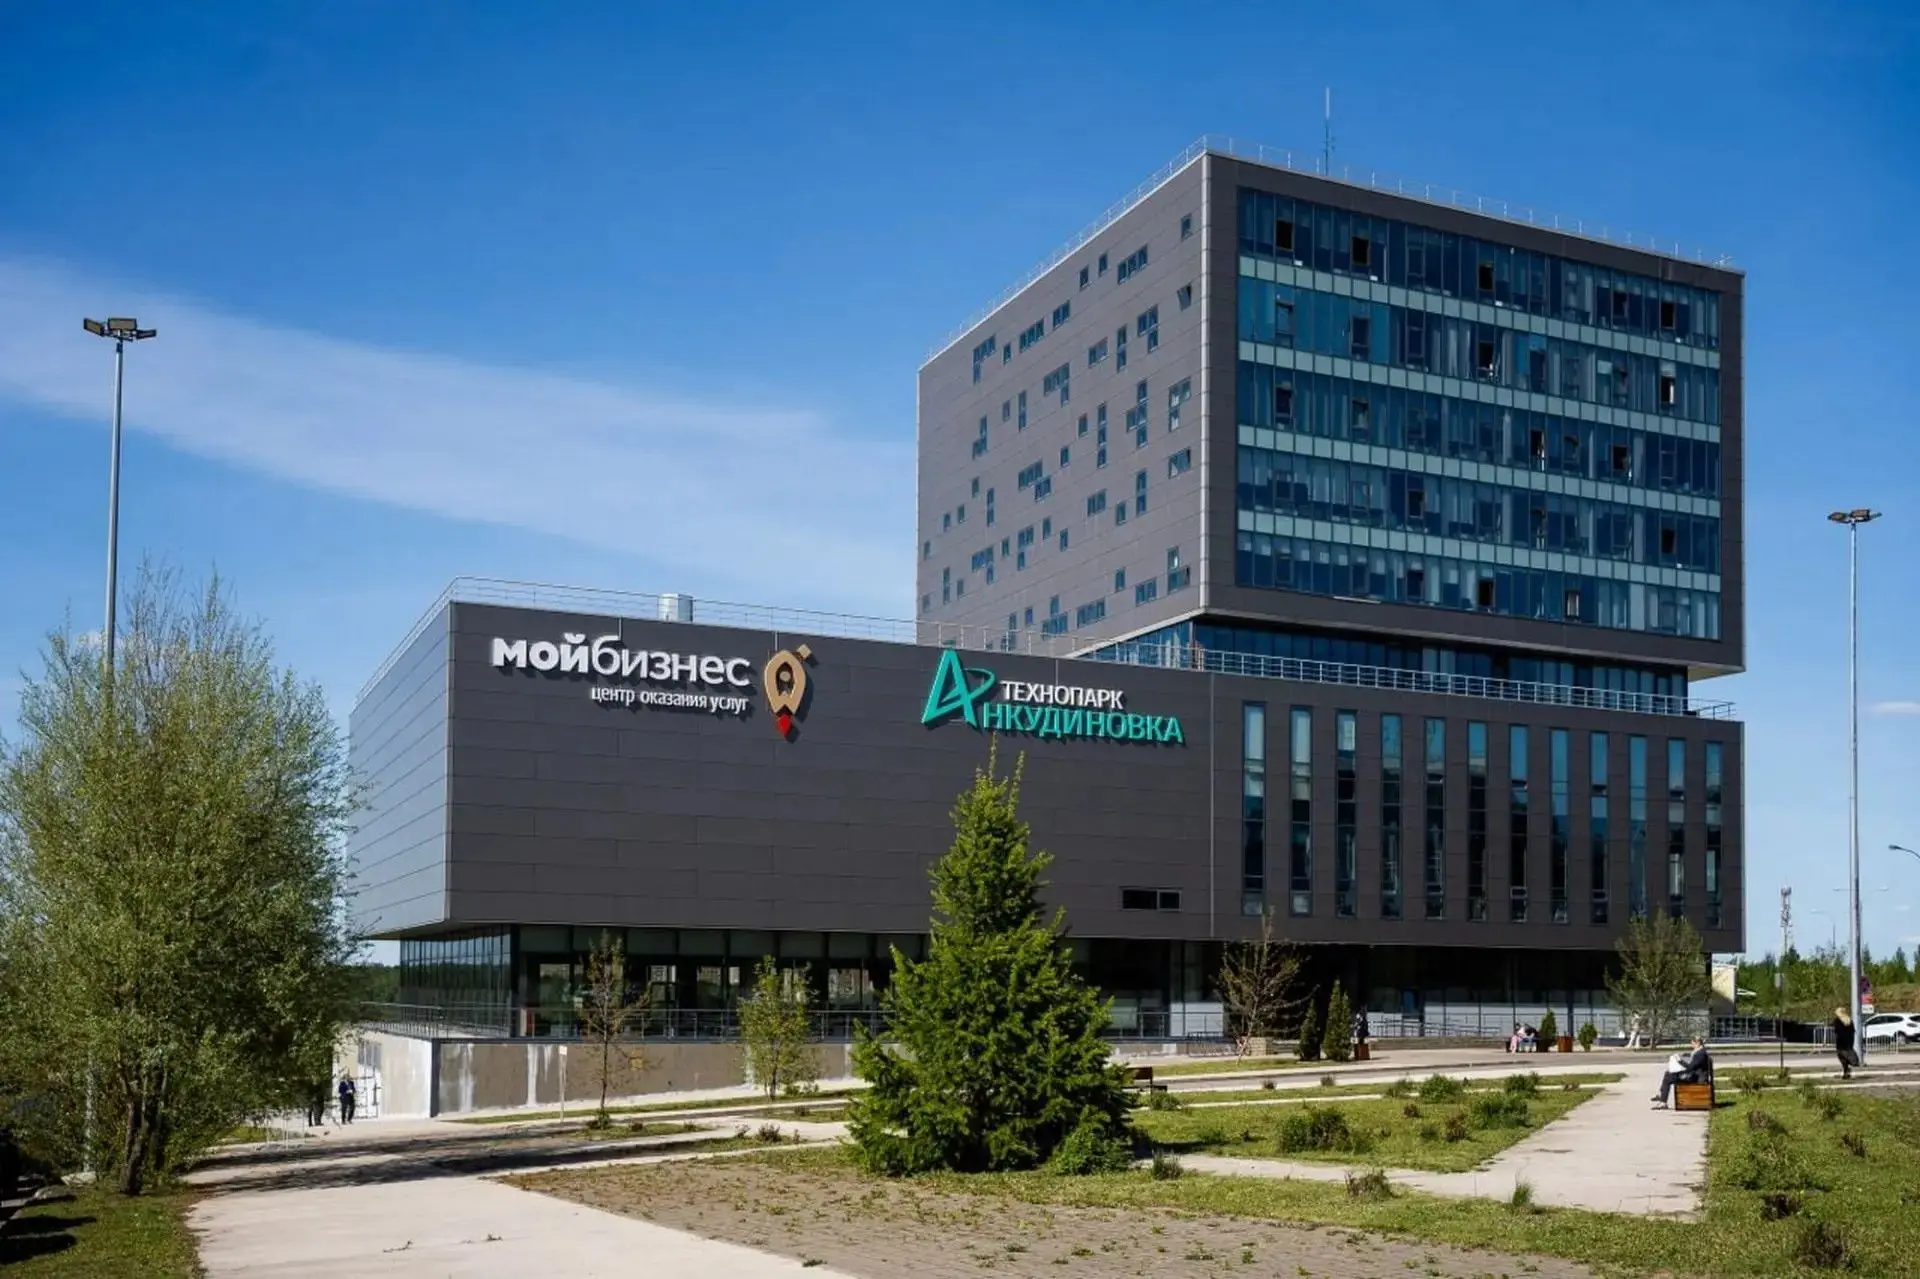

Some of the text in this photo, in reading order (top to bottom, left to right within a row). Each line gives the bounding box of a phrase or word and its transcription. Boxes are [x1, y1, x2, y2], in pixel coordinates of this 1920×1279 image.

[591, 686, 749, 714] центр оказания услуг
[1001, 680, 1123, 709] ТЕХНОПАРК
